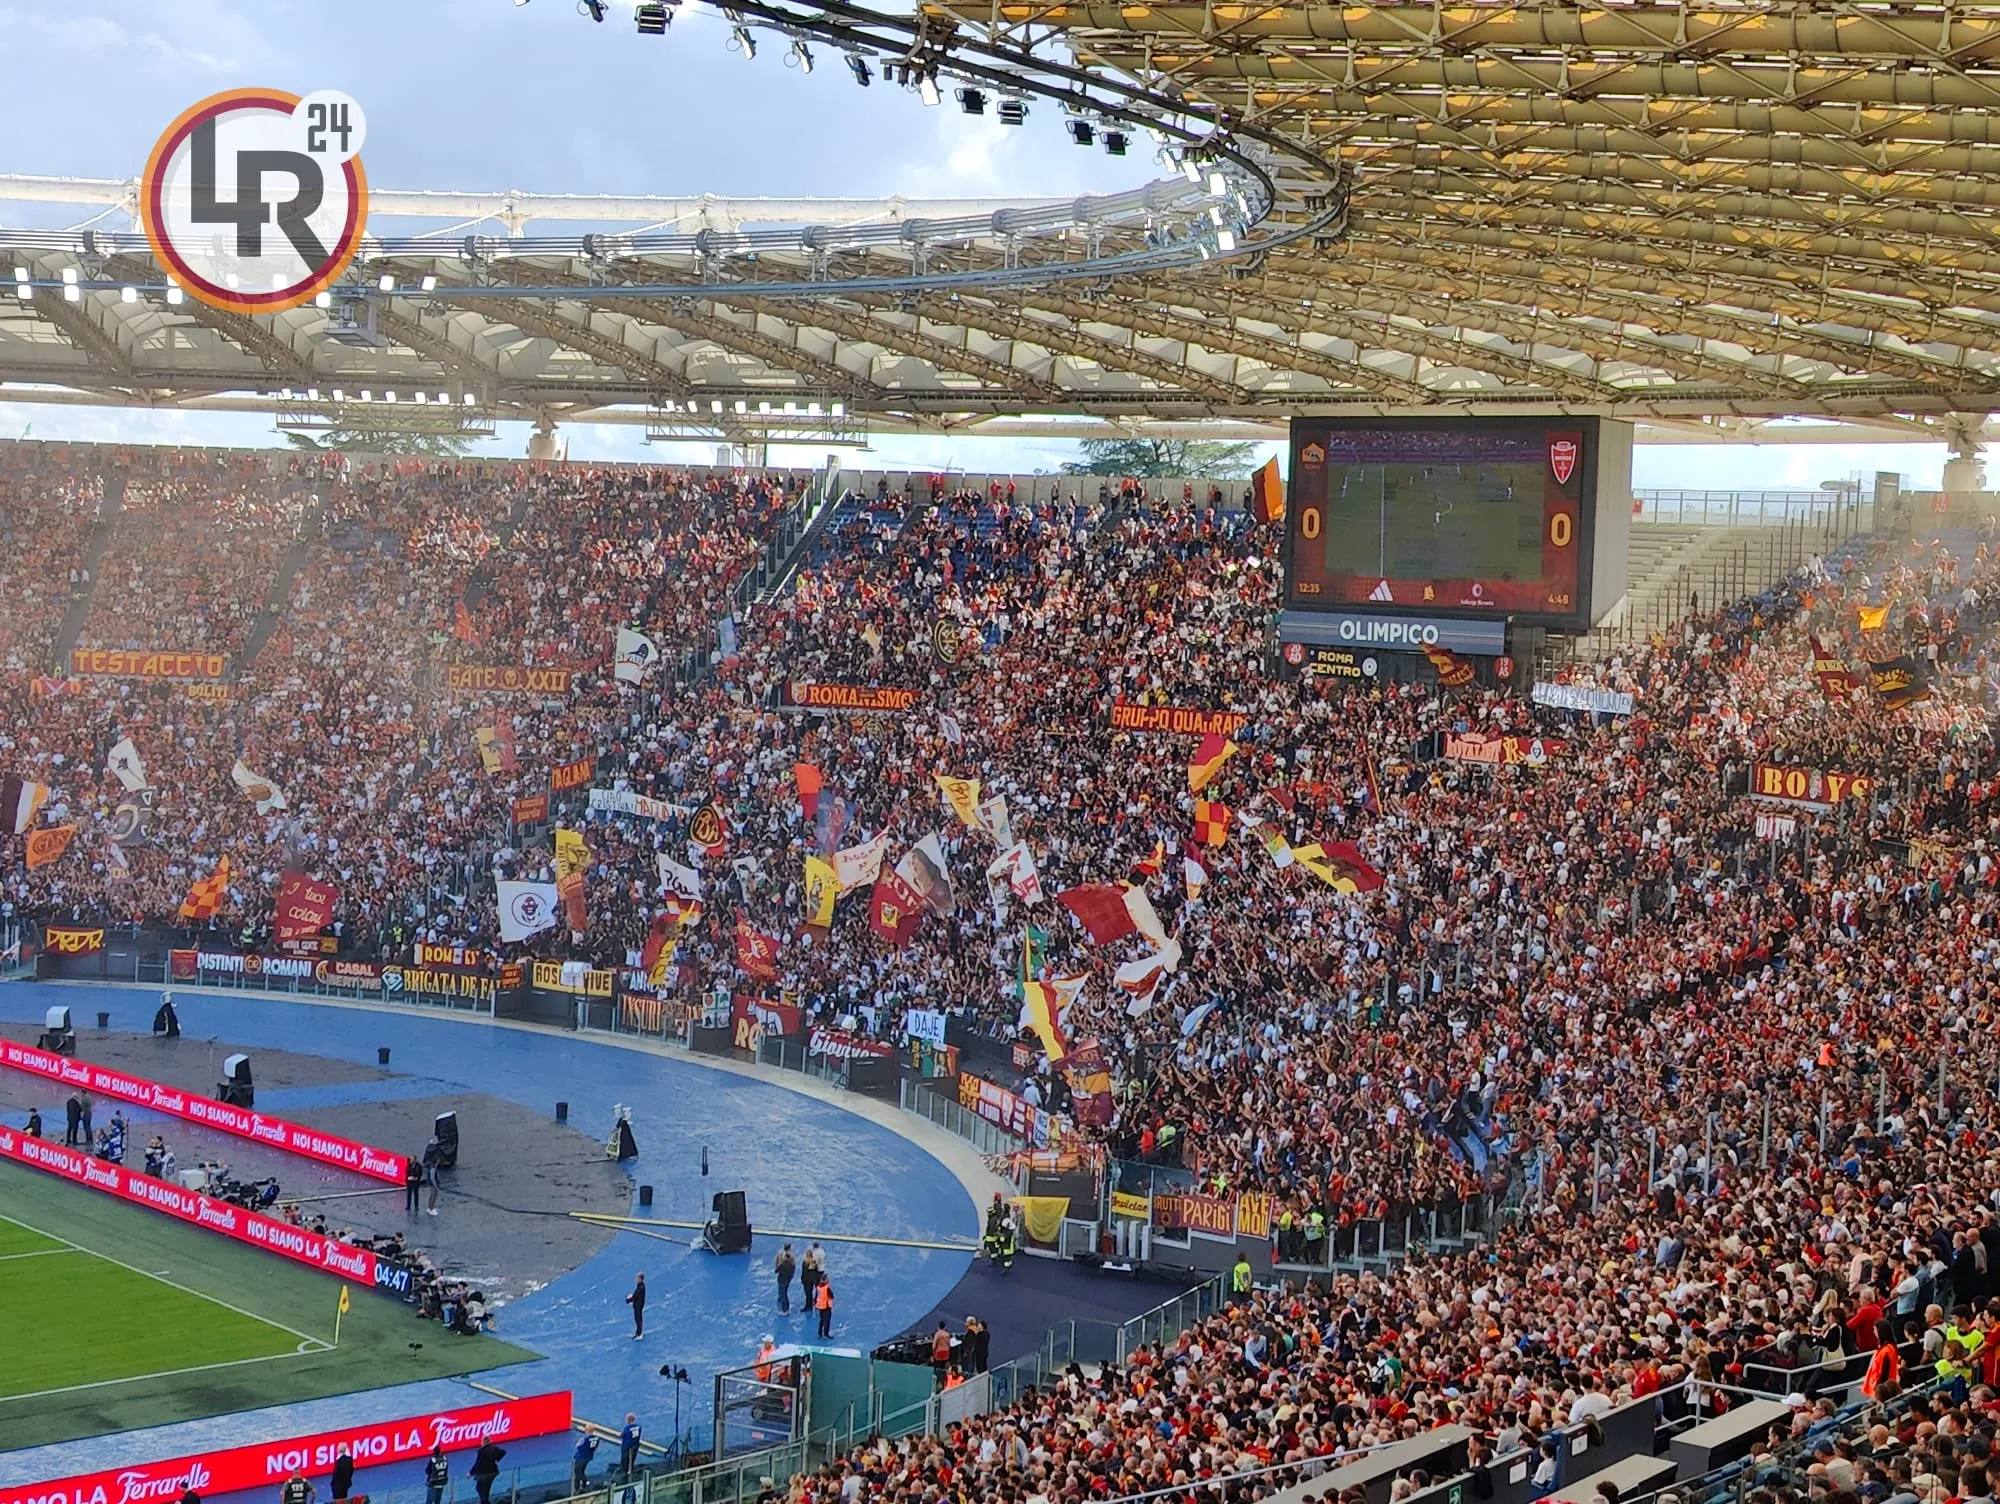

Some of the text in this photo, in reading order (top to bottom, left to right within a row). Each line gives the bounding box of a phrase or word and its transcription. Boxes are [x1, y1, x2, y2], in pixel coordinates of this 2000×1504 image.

[1302, 507, 1321, 539] 0
[1550, 513, 1571, 547] 0
[1340, 620, 1439, 646] OLIMPICO
[76, 651, 224, 677] TESTACCIO
[1310, 662, 1361, 678] CENTRO
[1318, 651, 1354, 664] ROMA
[448, 667, 567, 692] GATE XXII
[197, 953, 244, 974] DISTINTI
[263, 957, 312, 977] ROMANI
[335, 962, 375, 977] CASAL
[404, 969, 457, 996] BRIGATA
[460, 975, 478, 998] DE
[914, 1013, 939, 1037] DAJE
[8, 1048, 22, 1062] NOI
[23, 1052, 48, 1071] SIAMO
[48, 1061, 59, 1073] LA
[95, 1073, 110, 1088] NOI
[111, 1079, 137, 1098] SIAMO
[138, 1087, 151, 1101] LA
[190, 1101, 206, 1117] NOI
[207, 1108, 235, 1127] SIAMO
[236, 1117, 249, 1132] LA
[22, 1142, 39, 1158] NOI
[40, 1147, 68, 1168] SIAMO
[69, 1160, 82, 1175] LA
[292, 1132, 398, 1178] NOI SIAMO LA Ferrarelle
[129, 1179, 237, 1231] NOI SIAMO LA Ferrarelle
[247, 1220, 367, 1277] NOI SIAMO LA Ferrarelle
[374, 1263, 409, 1292] 04:47
[266, 1453, 307, 1475] NOI
[394, 1430, 422, 1453] LA
[428, 1409, 511, 1450] Ferrarelle
[75, 1485, 107, 1504] LA
